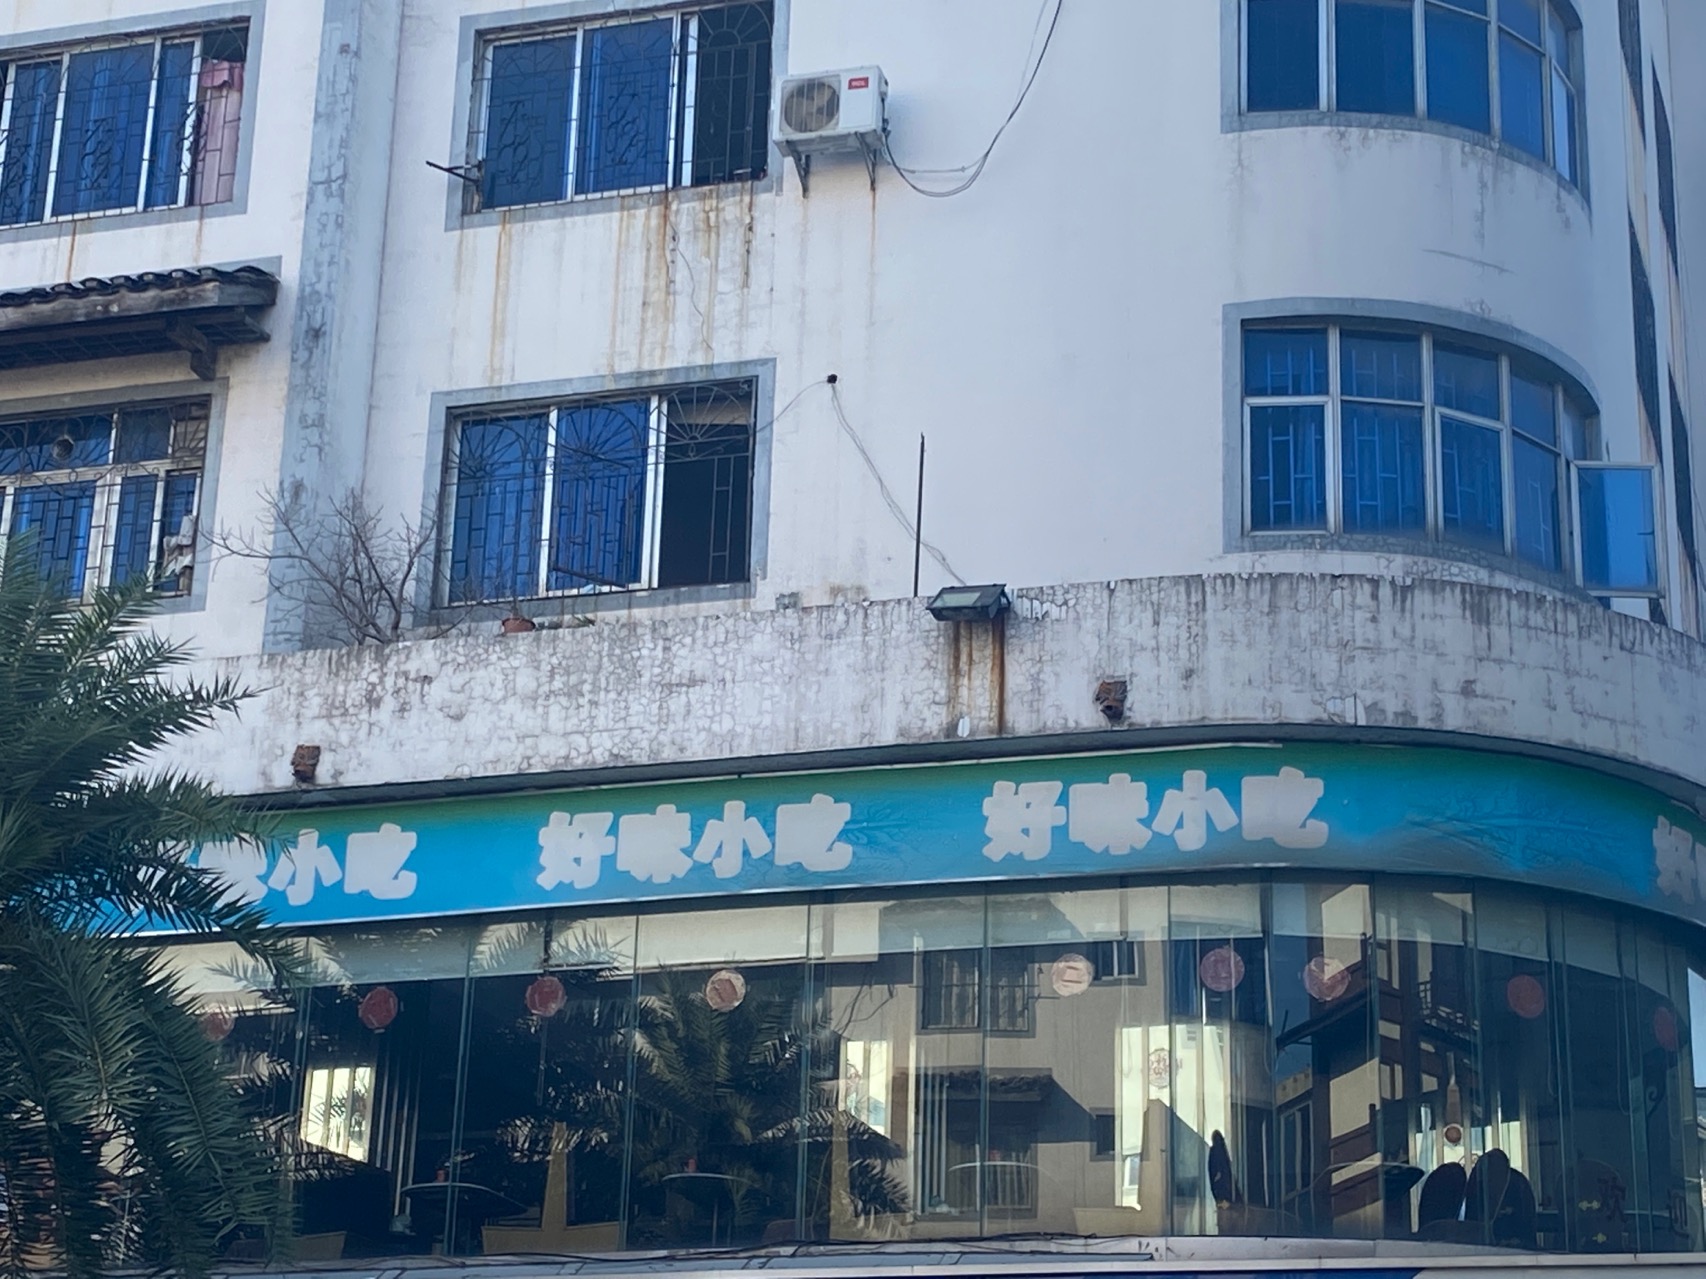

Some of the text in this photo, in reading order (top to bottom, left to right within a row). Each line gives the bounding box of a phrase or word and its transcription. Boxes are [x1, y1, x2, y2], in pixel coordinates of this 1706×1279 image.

[536, 793, 853, 890] 好味小吃
[982, 766, 1329, 862] 好味小吃
